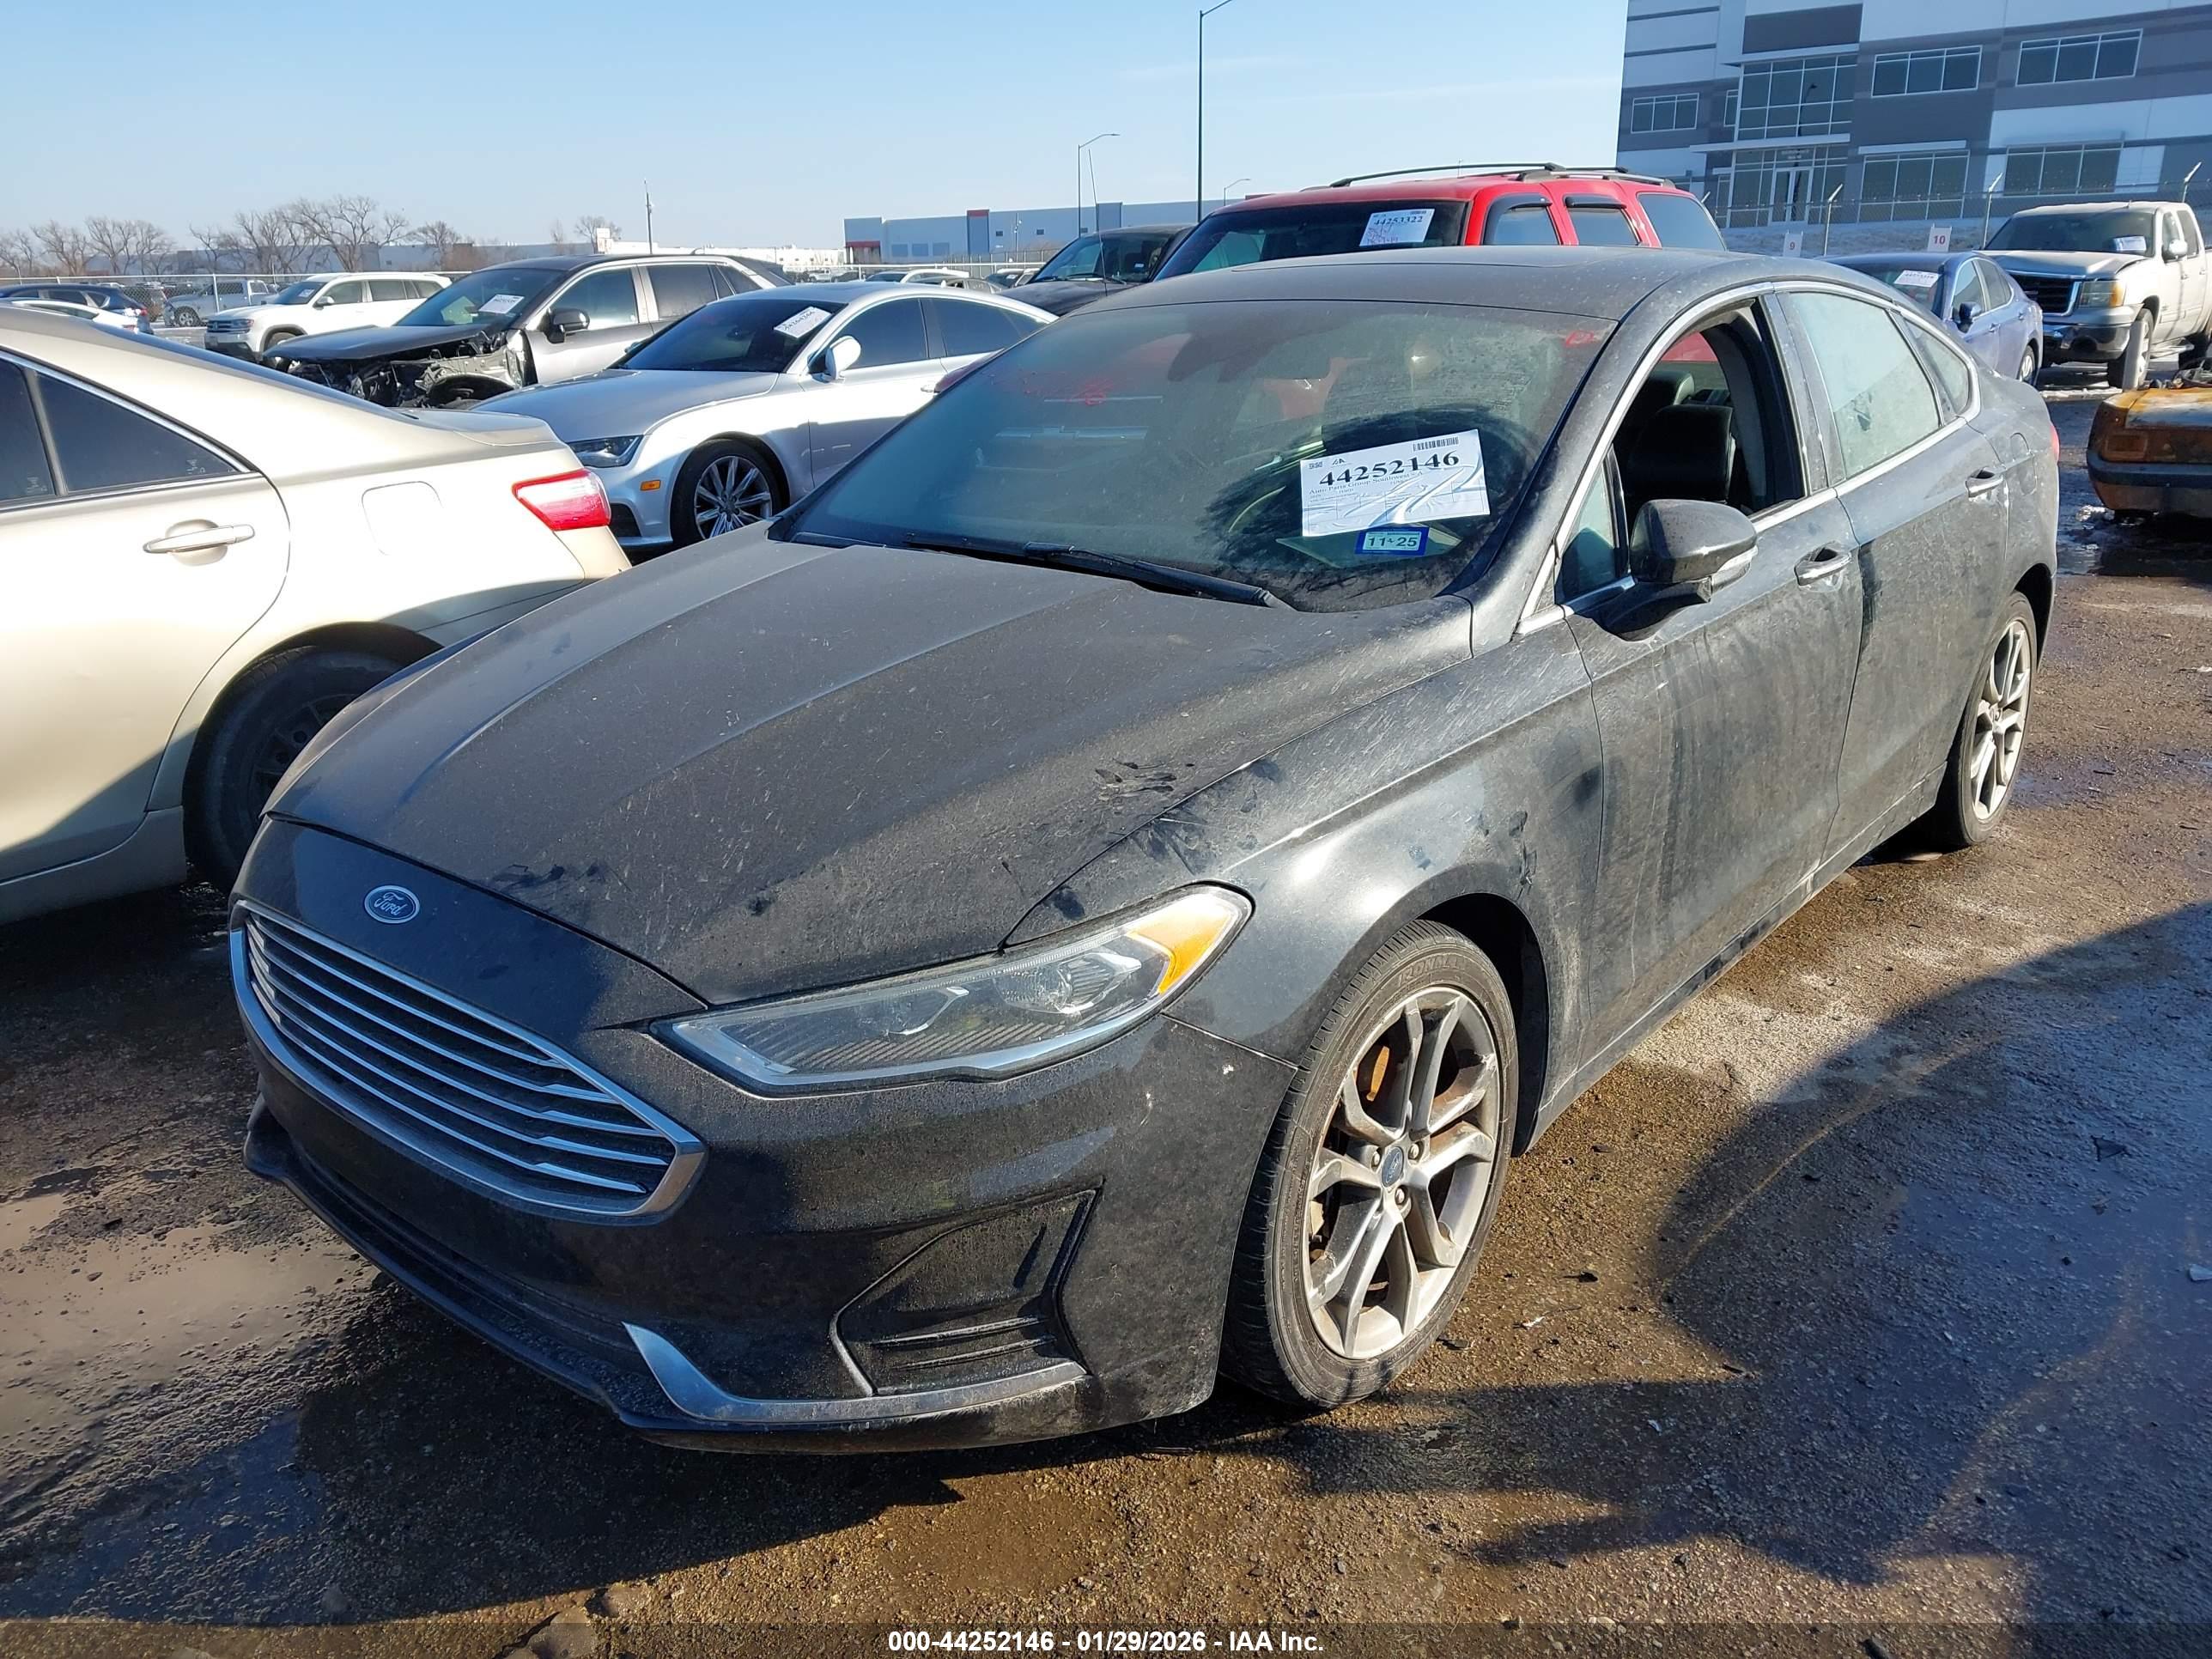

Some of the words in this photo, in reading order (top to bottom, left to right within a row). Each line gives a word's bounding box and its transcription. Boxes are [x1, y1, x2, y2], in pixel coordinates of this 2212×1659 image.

[1789, 241, 1796, 251] 9
[1932, 234, 1947, 246] 10
[1319, 451, 1460, 486] 44252146
[1368, 537, 1386, 547] 11
[1396, 537, 1418, 547] 25
[374, 891, 409, 916] Ford
